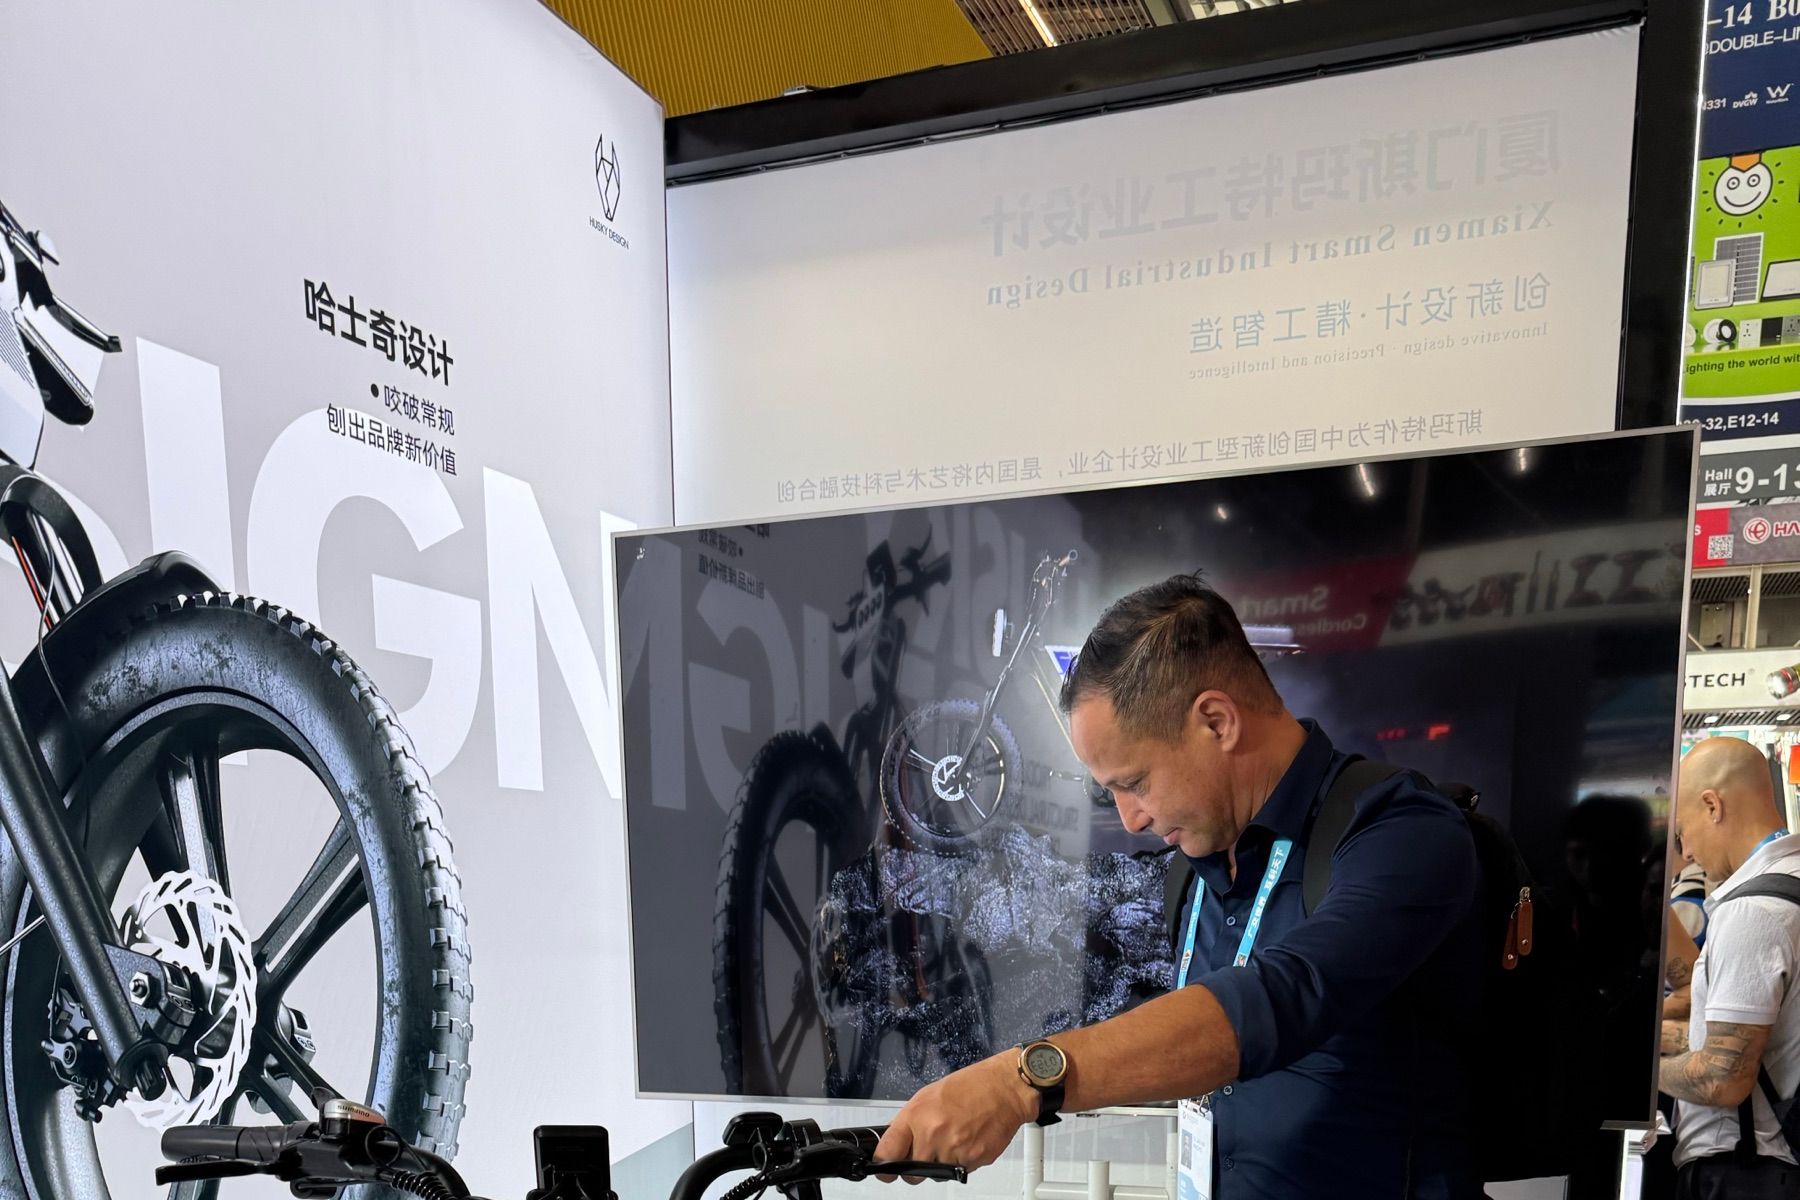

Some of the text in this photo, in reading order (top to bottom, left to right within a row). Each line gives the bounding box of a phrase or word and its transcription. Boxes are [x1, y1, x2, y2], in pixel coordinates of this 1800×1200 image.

[1705, 27, 1800, 55] DOUBLE-LI
[589, 215, 630, 250] HUSKY DESIGN
[304, 278, 454, 386] 哈士奇设计
[1728, 360, 1746, 369] the
[1749, 355, 1780, 366] world
[384, 384, 455, 436] 咬破常规
[1681, 411, 1780, 431] -32,E12-14
[326, 403, 457, 476] 刨出品牌新价值
[1704, 468, 1732, 482] Hall
[1704, 482, 1731, 496] 展厅
[1685, 672, 1746, 689] TECH
